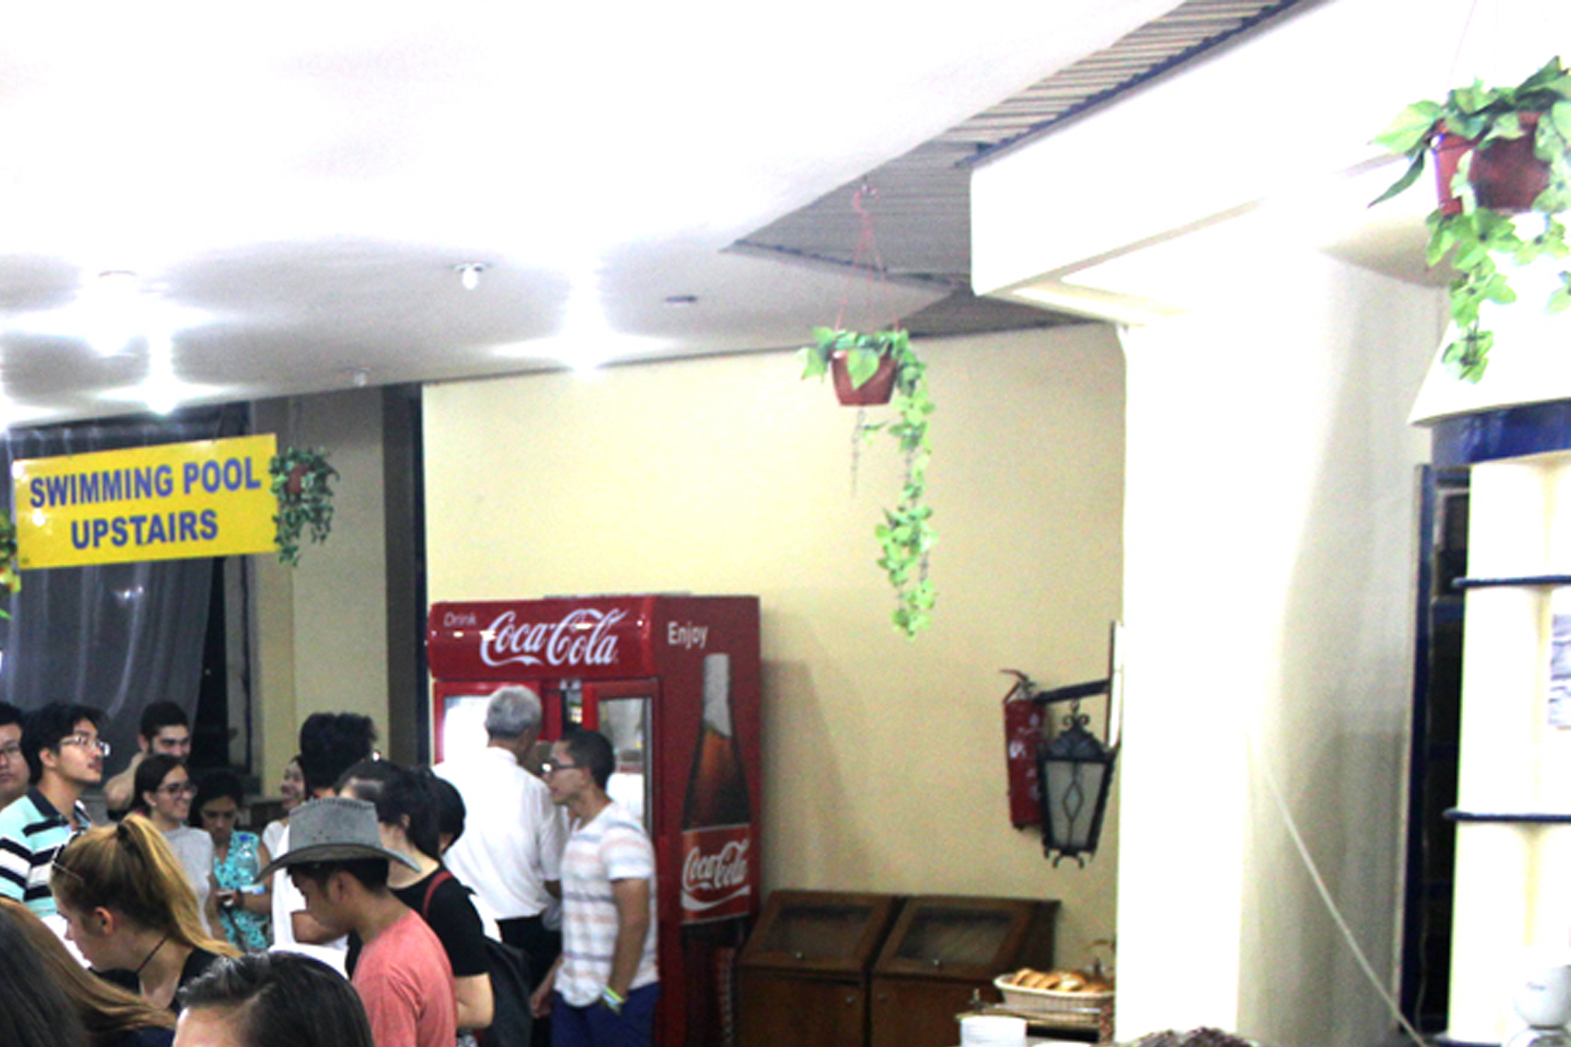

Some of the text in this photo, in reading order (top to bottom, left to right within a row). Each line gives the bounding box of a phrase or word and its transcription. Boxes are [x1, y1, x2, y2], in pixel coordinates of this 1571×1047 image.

[30, 457, 262, 508] SWIMMING POOL
[70, 508, 219, 549] UPSTAIRS
[443, 611, 477, 627] Drink
[667, 621, 709, 649] Enjoy
